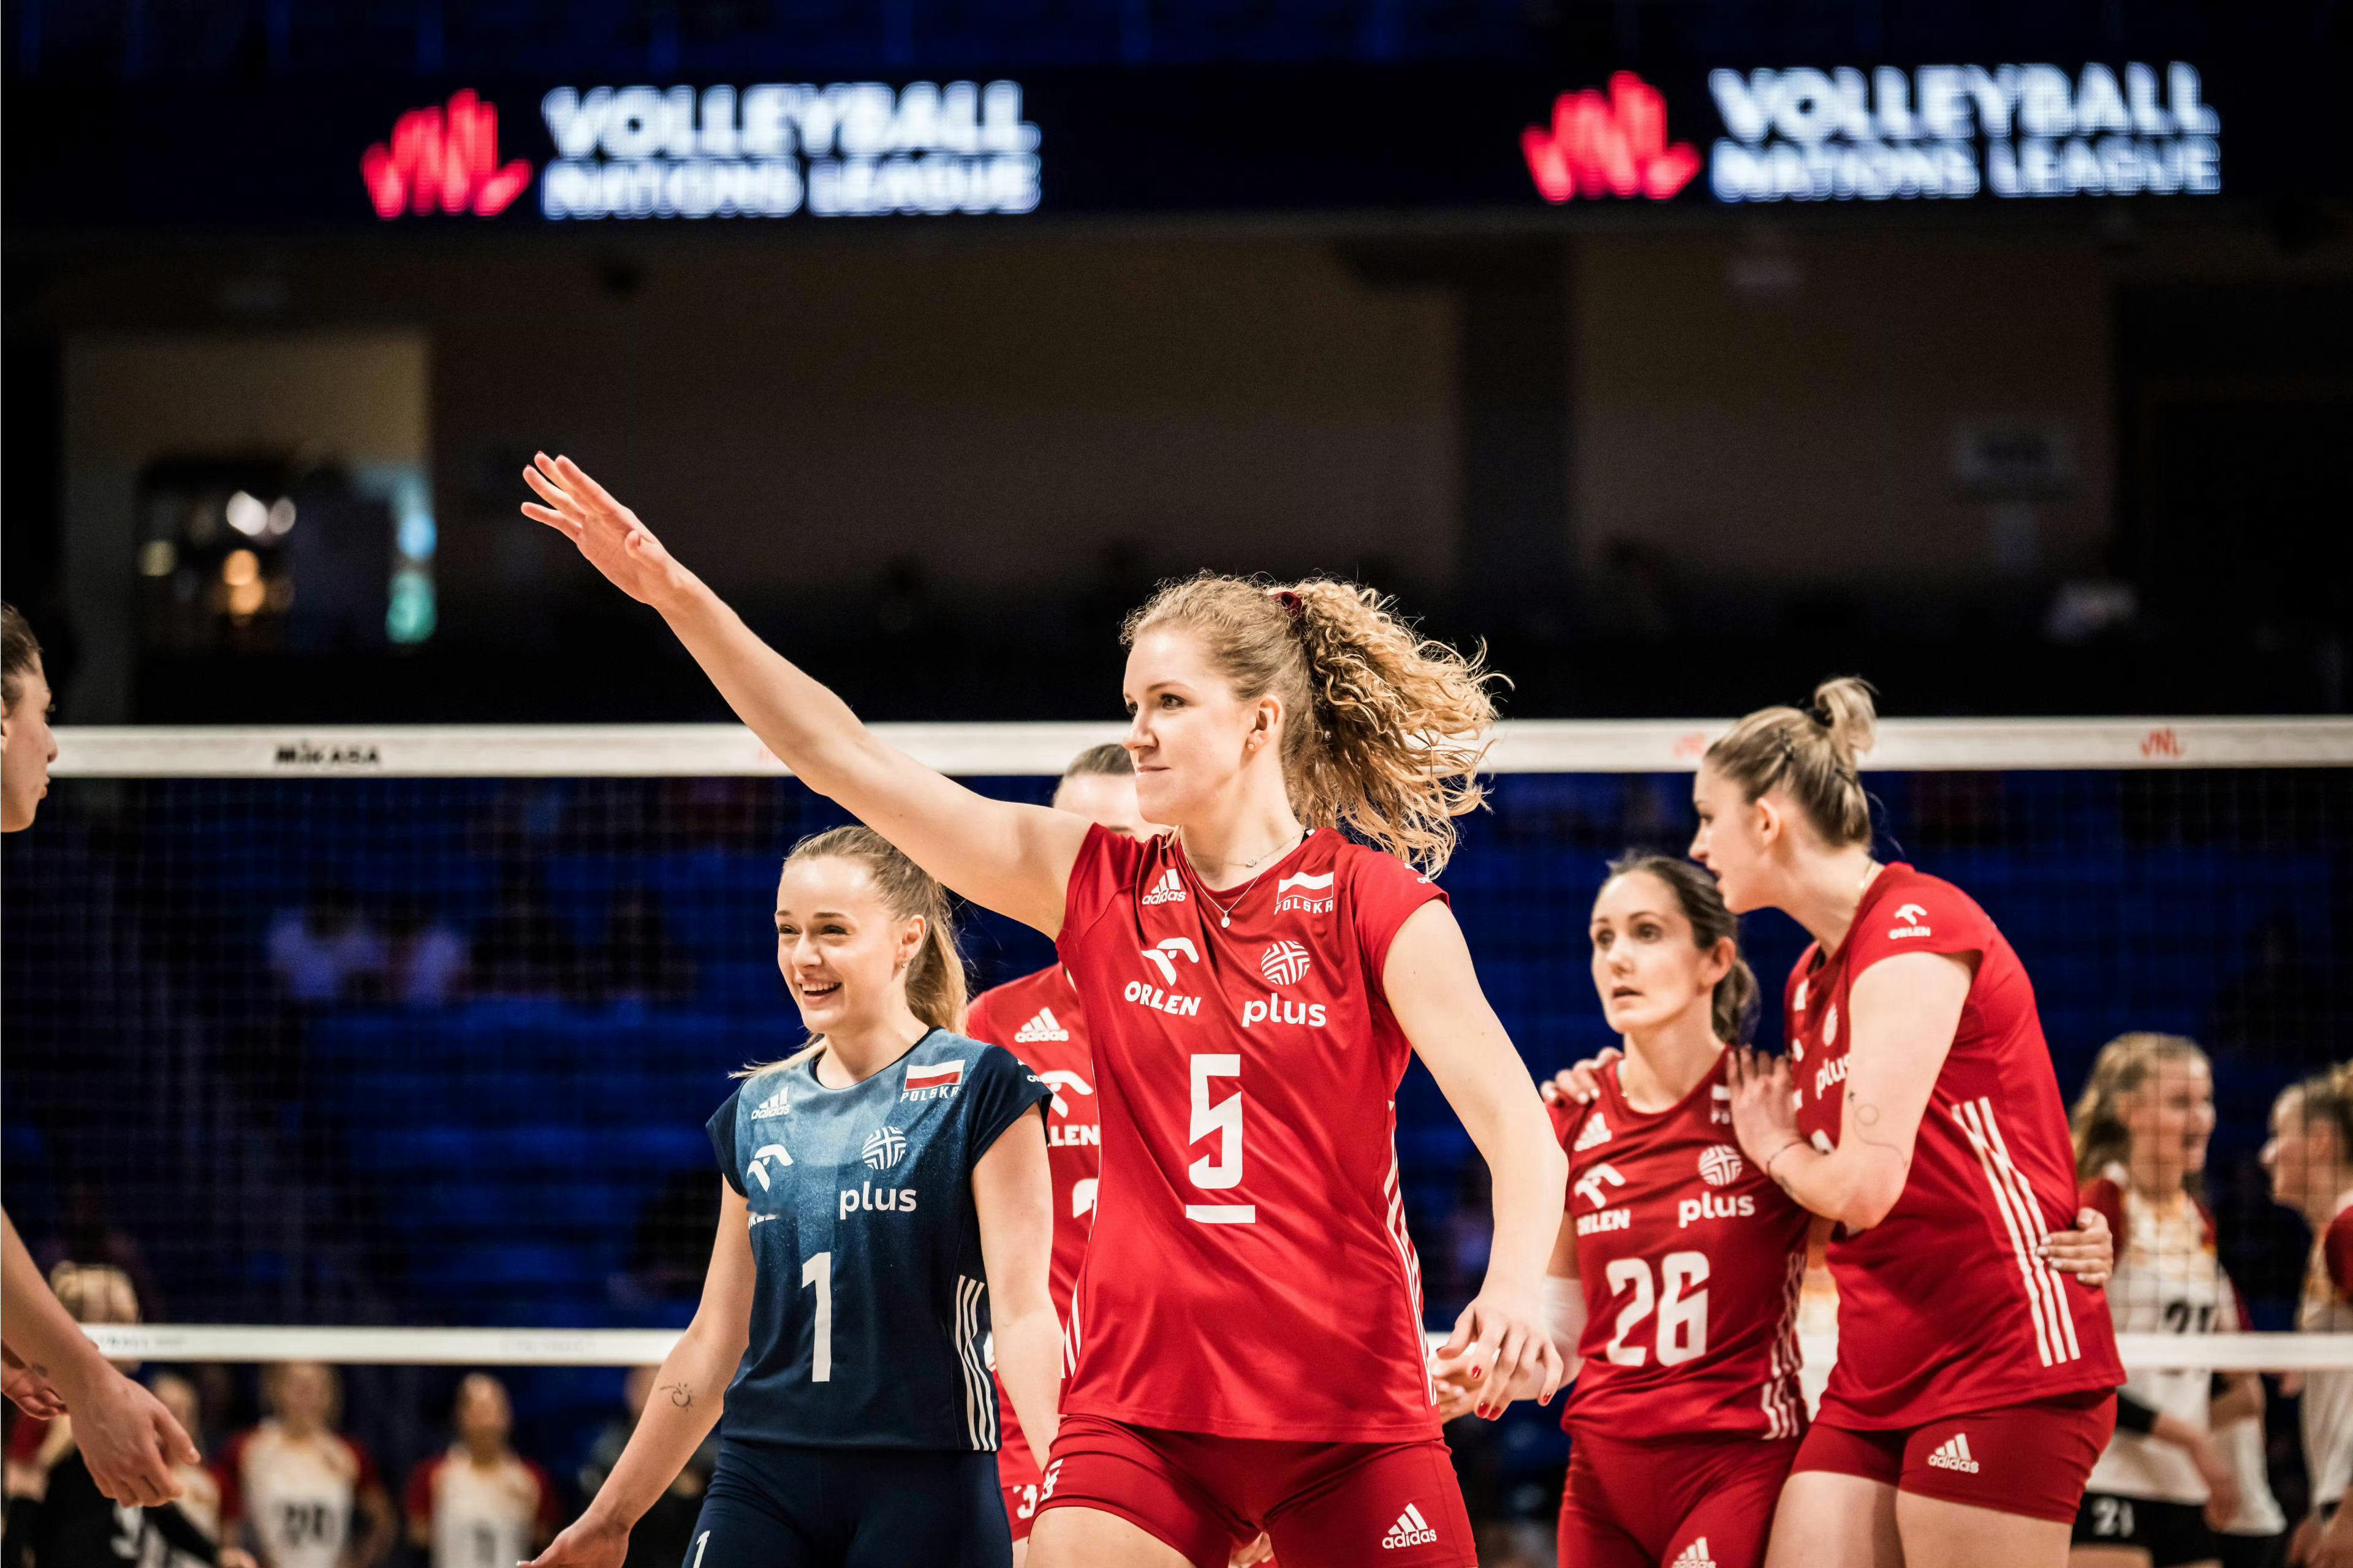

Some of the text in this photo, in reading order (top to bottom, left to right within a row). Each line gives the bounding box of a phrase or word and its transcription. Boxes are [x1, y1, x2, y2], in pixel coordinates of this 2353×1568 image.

[542, 81, 1040, 157] VOLLEYBALL
[1710, 62, 2219, 141] VOLLEYBALL
[540, 152, 1040, 219] NATIONS LEAGUE
[1710, 136, 2220, 201] NATIONS LEAGUE
[1142, 887, 1186, 905] adidas
[1274, 898, 1334, 916] POLSKA
[1889, 926, 1931, 939] ORLEN
[1124, 980, 1201, 1017] ORLEN
[1241, 993, 1327, 1028] plus
[1015, 1029, 1069, 1042] adidas
[751, 1104, 790, 1120] adidas
[900, 1086, 960, 1103] POLSKA
[1047, 1124, 1101, 1147] LEN
[1188, 1054, 1243, 1189] 5
[839, 1181, 917, 1220] plus
[1678, 1191, 1756, 1229] plus
[801, 1251, 831, 1382] 1
[1605, 1251, 1710, 1367] 26
[1928, 1455, 1979, 1474] adidas
[1382, 1529, 1437, 1549] adidas
